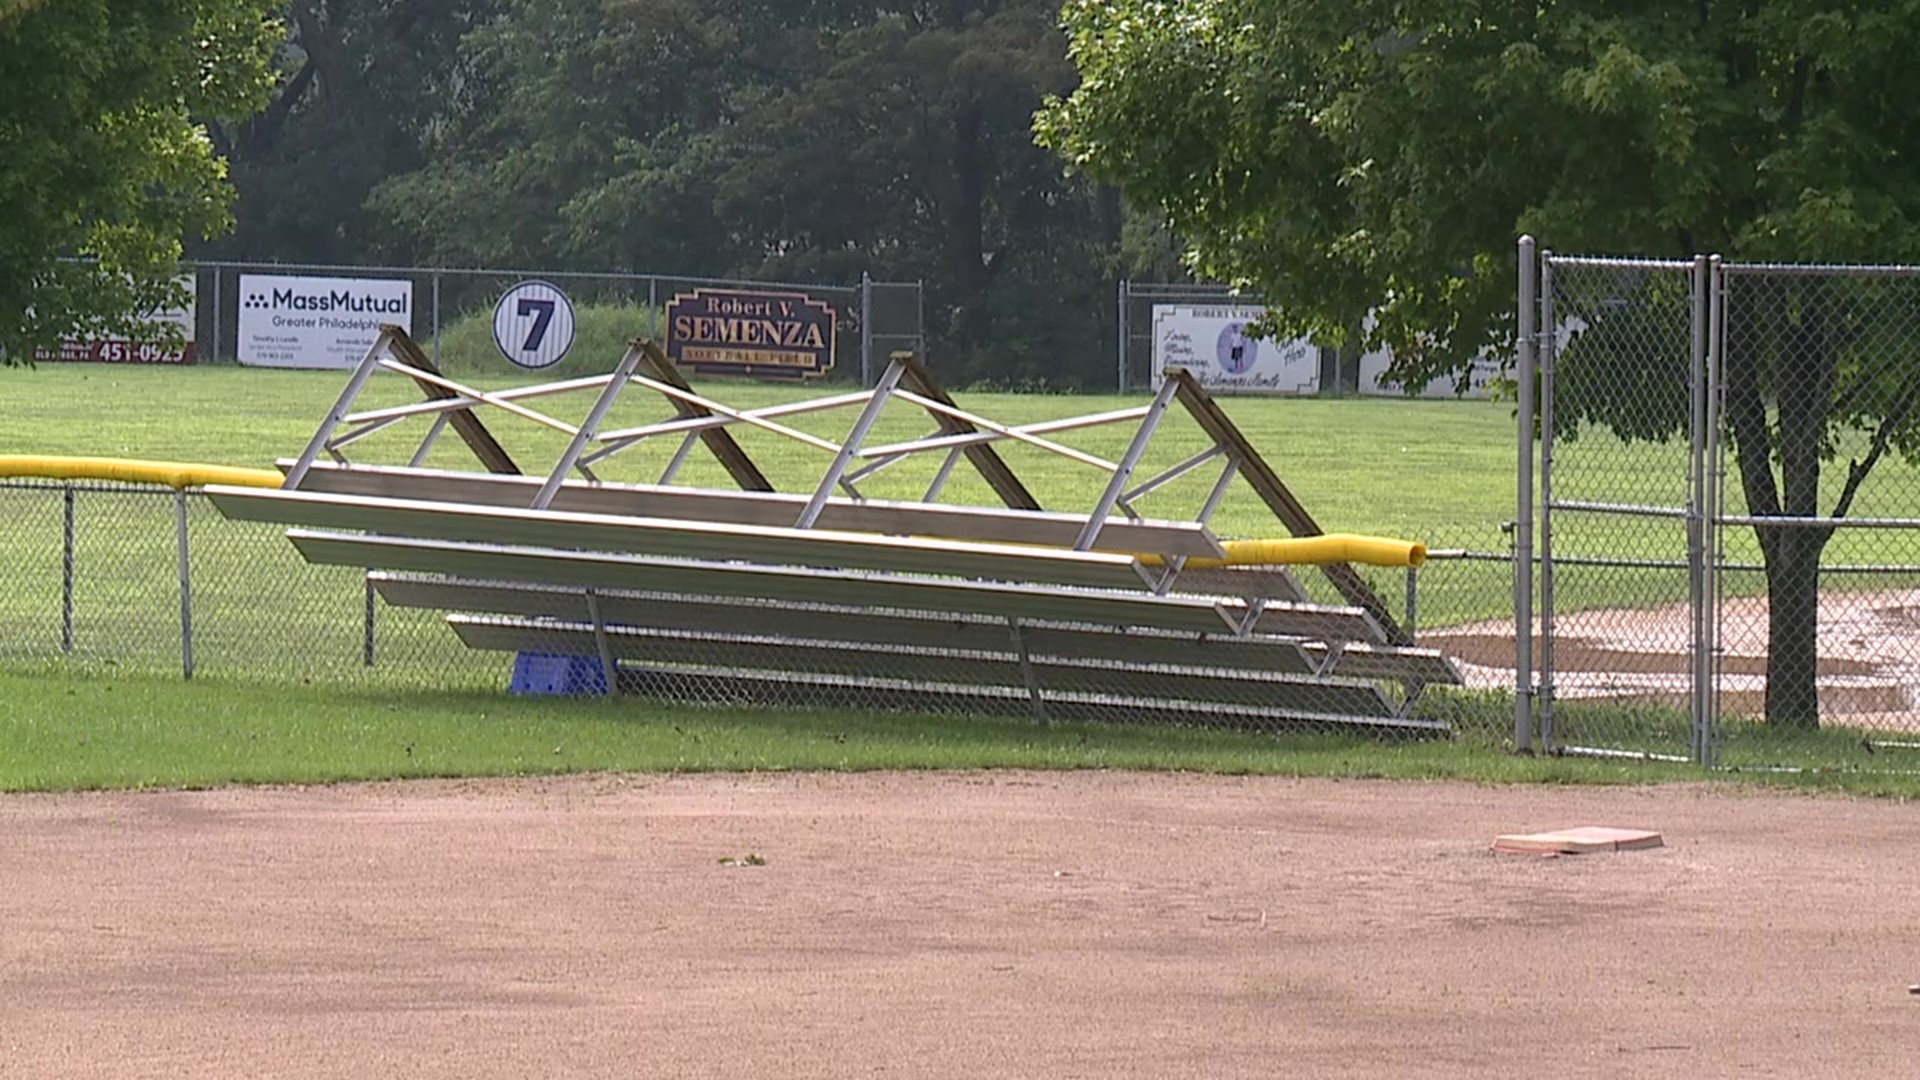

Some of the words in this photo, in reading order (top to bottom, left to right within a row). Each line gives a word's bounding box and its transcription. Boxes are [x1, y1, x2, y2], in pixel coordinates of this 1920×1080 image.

[272, 288, 407, 314] MassMutual
[706, 297, 772, 317] Robert
[779, 301, 796, 318] V.
[272, 315, 316, 328] Greater
[319, 316, 379, 332] Philadelphi
[517, 299, 555, 351] 7
[673, 316, 825, 349] SEMENZA
